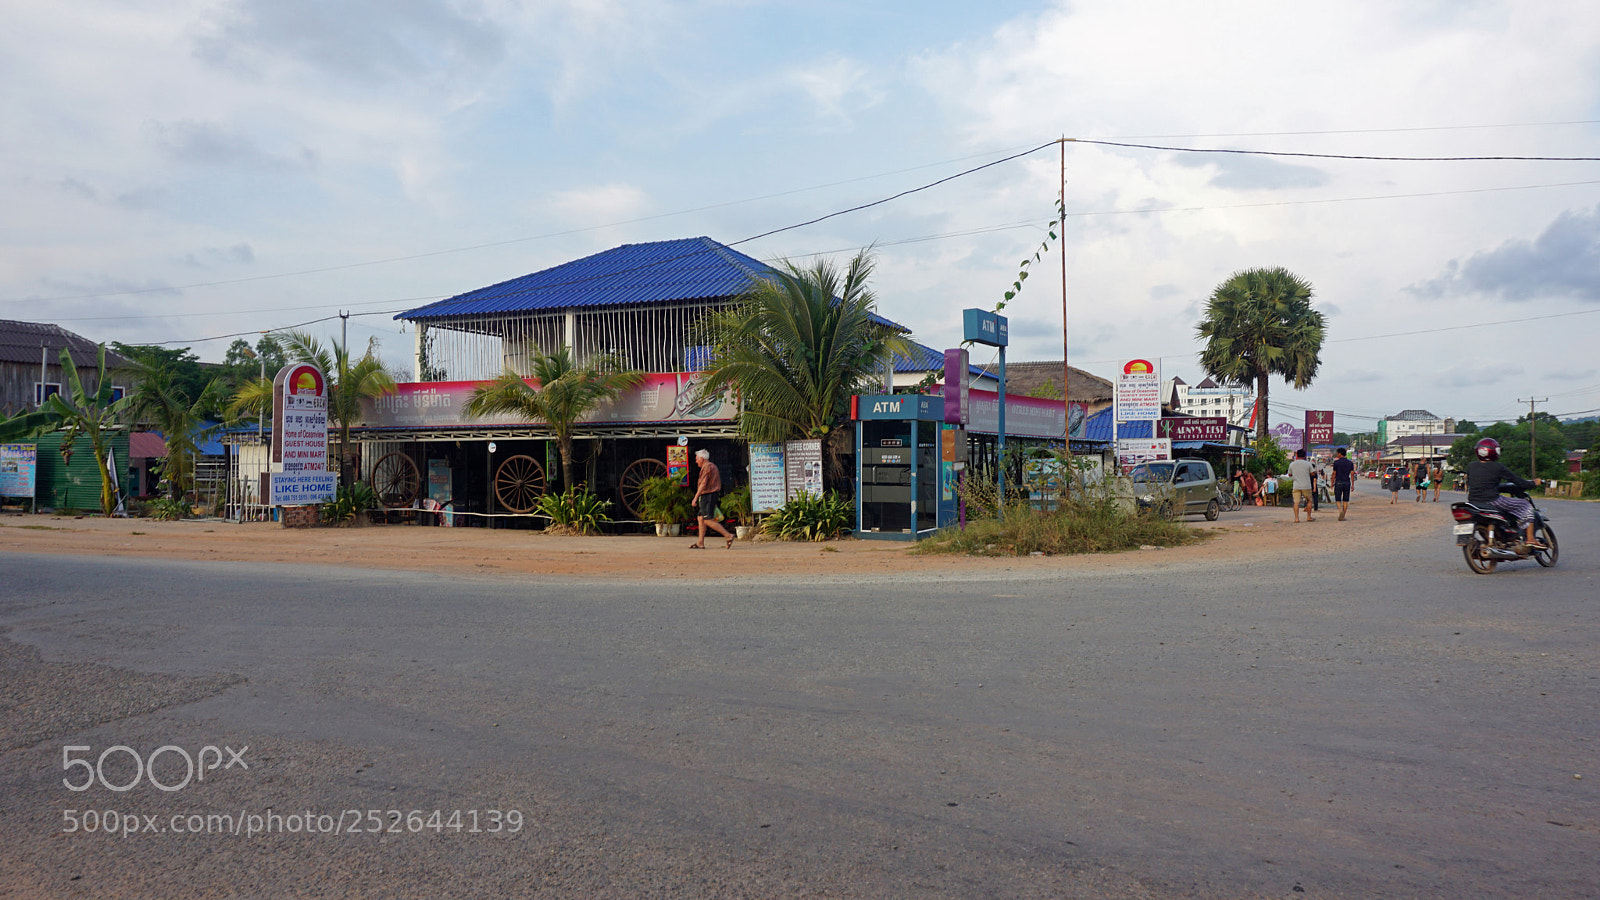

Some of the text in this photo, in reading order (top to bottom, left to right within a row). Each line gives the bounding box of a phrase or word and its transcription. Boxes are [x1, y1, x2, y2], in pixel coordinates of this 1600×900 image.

[982, 319, 995, 334] ATM
[873, 402, 900, 413] ATM
[285, 430, 325, 439] Home of Oceanview
[787, 442, 821, 451] COFFEE CORNER
[274, 476, 296, 484] STAYING
[275, 483, 332, 493] LIKE HOME
